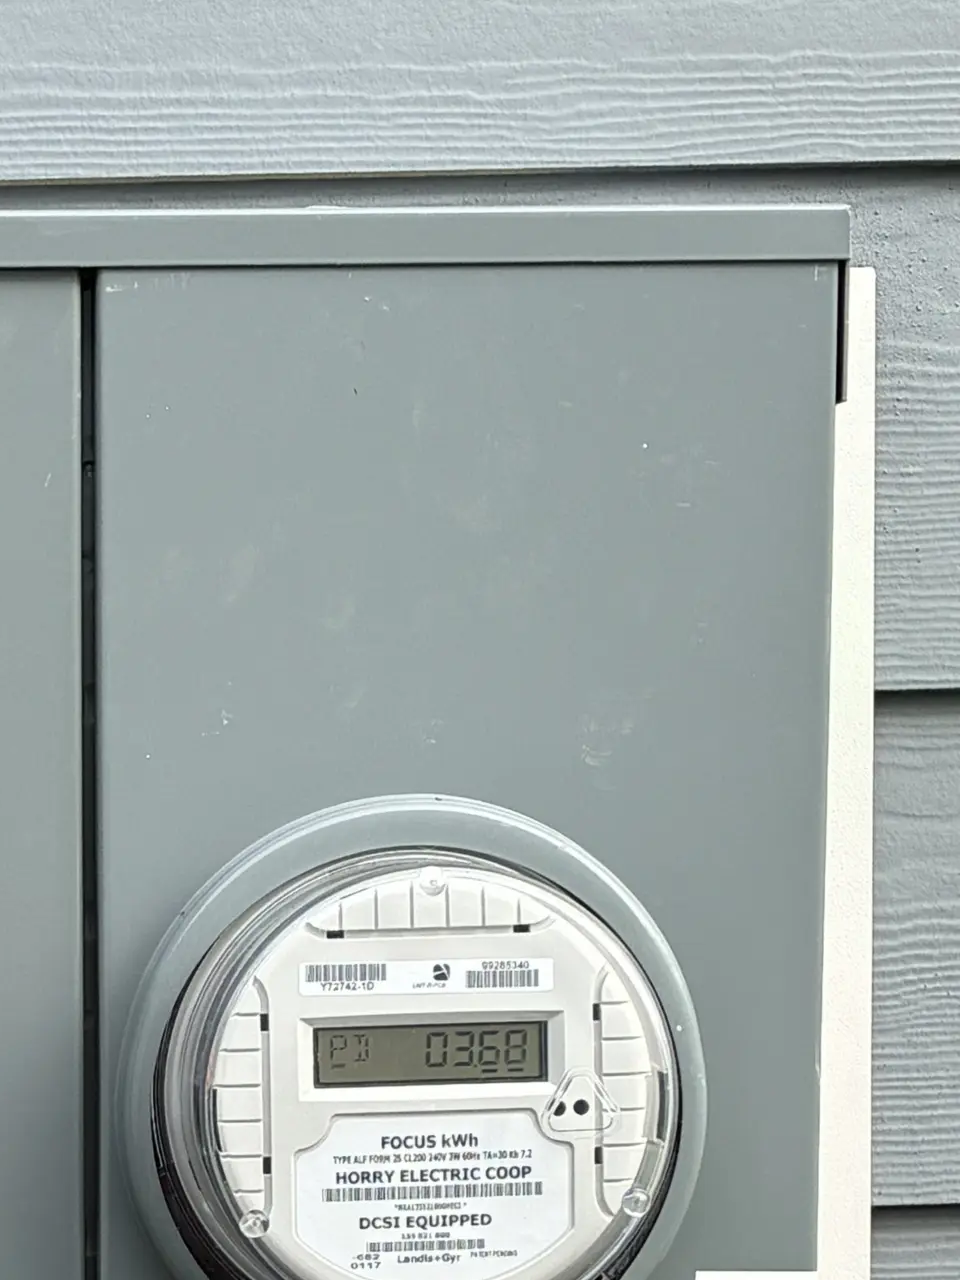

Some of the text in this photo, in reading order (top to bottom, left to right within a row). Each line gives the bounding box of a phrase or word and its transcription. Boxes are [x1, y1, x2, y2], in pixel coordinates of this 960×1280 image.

[481, 960, 530, 970] 99285340
[381, 1132, 479, 1150] FOCUS kWh
[335, 1166, 532, 1185] HORRY ELECTRIC COOP
[359, 1213, 493, 1230] DCSI EQUIPPED
[397, 1252, 461, 1264] Landis+Gyr
